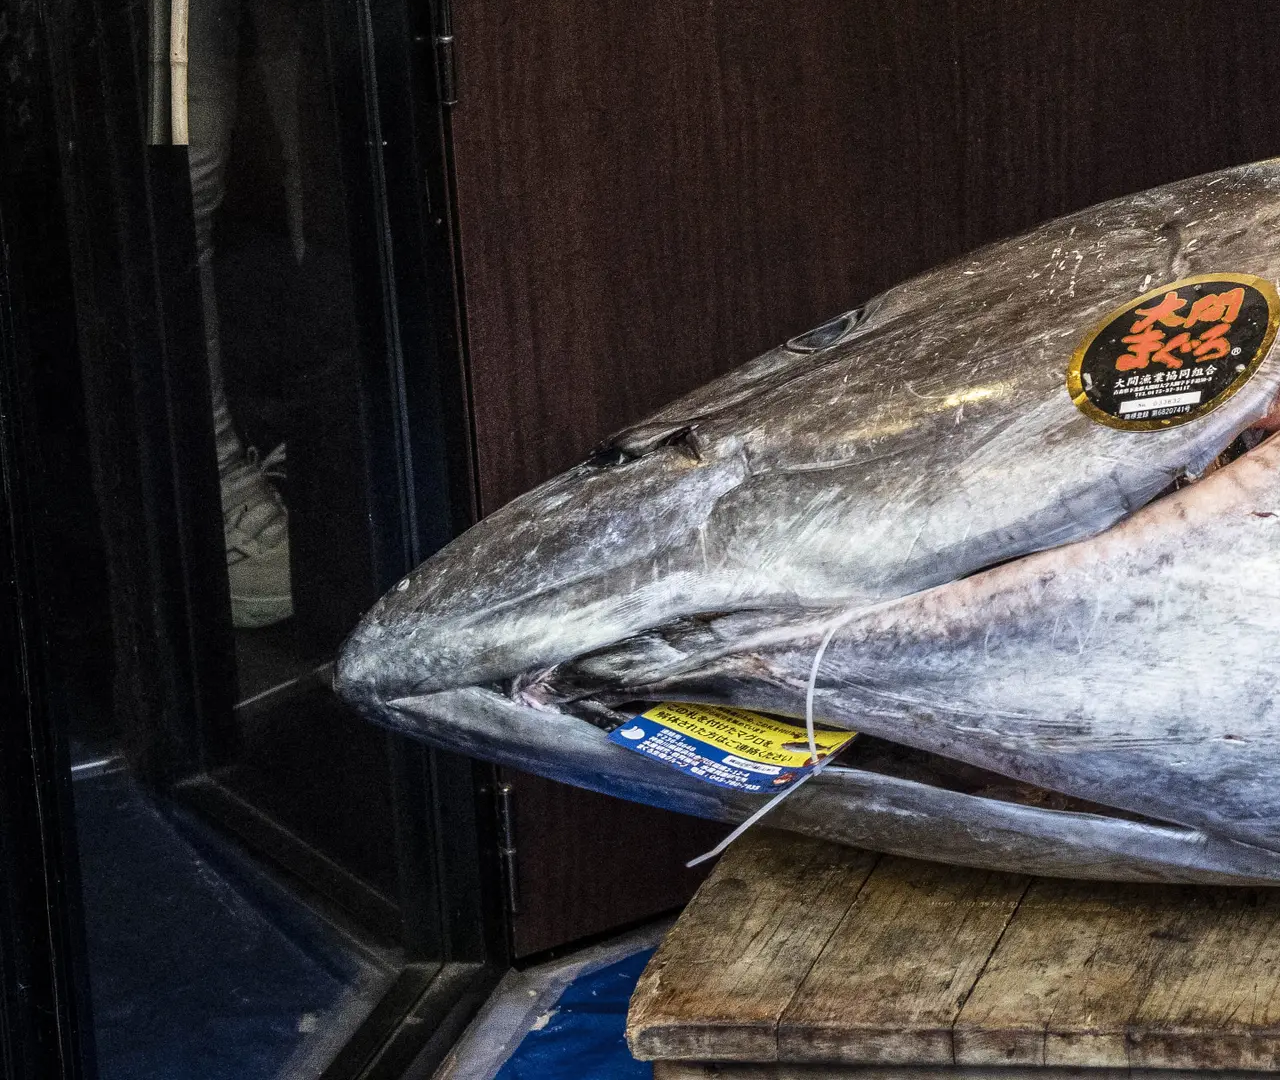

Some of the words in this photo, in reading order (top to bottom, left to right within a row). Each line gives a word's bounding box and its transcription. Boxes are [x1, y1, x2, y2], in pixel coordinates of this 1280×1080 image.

[1129, 287, 1245, 334] 大間
[1115, 322, 1231, 371] まぐろ
[1114, 364, 1218, 389] 大間漁業協同組合
